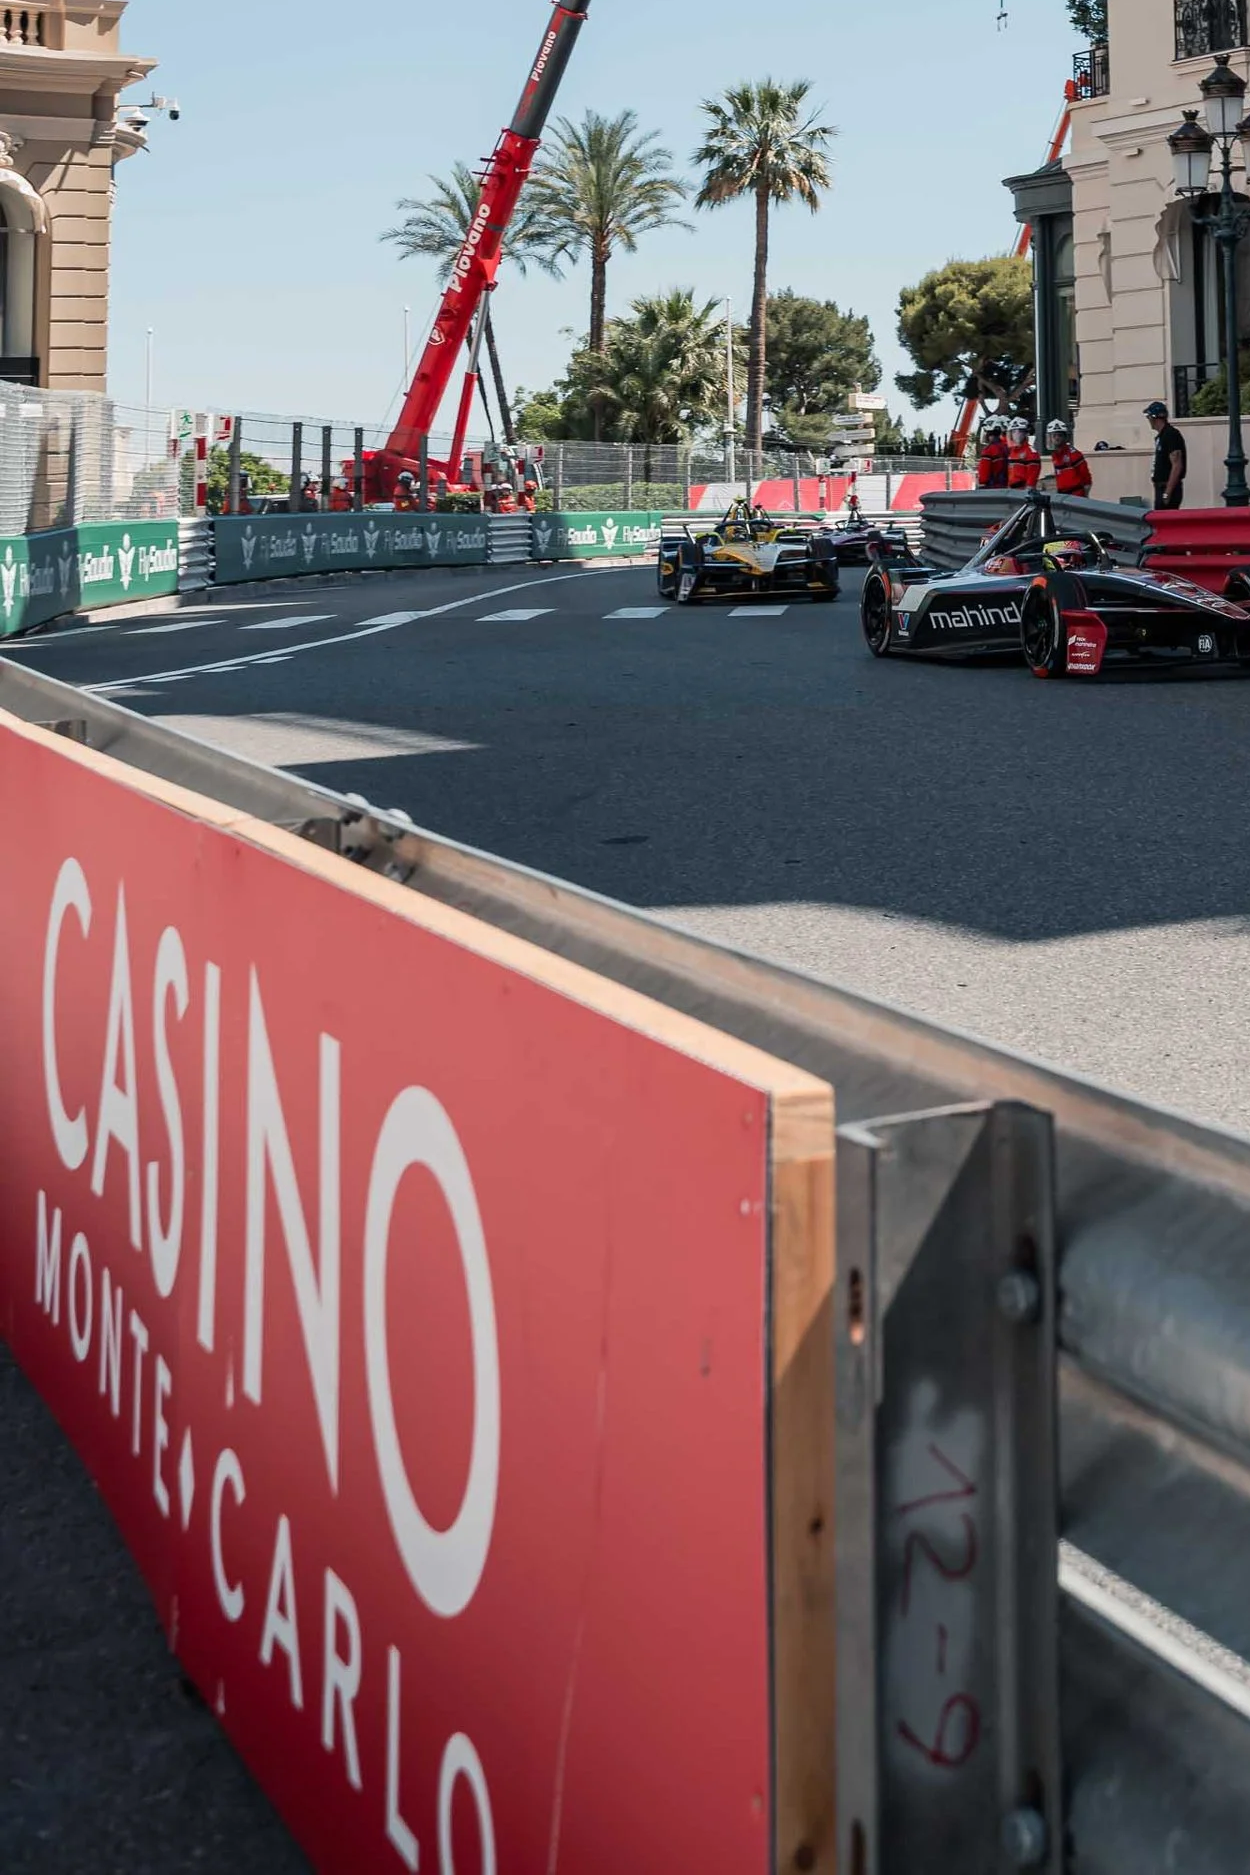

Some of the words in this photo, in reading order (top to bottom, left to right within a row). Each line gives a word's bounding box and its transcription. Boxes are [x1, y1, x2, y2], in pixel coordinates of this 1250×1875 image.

[447, 203, 490, 293] Piovano
[34, 1189, 171, 1521] MONTE
[42, 856, 500, 1617] CASINO
[897, 1438, 982, 1773] 12-9
